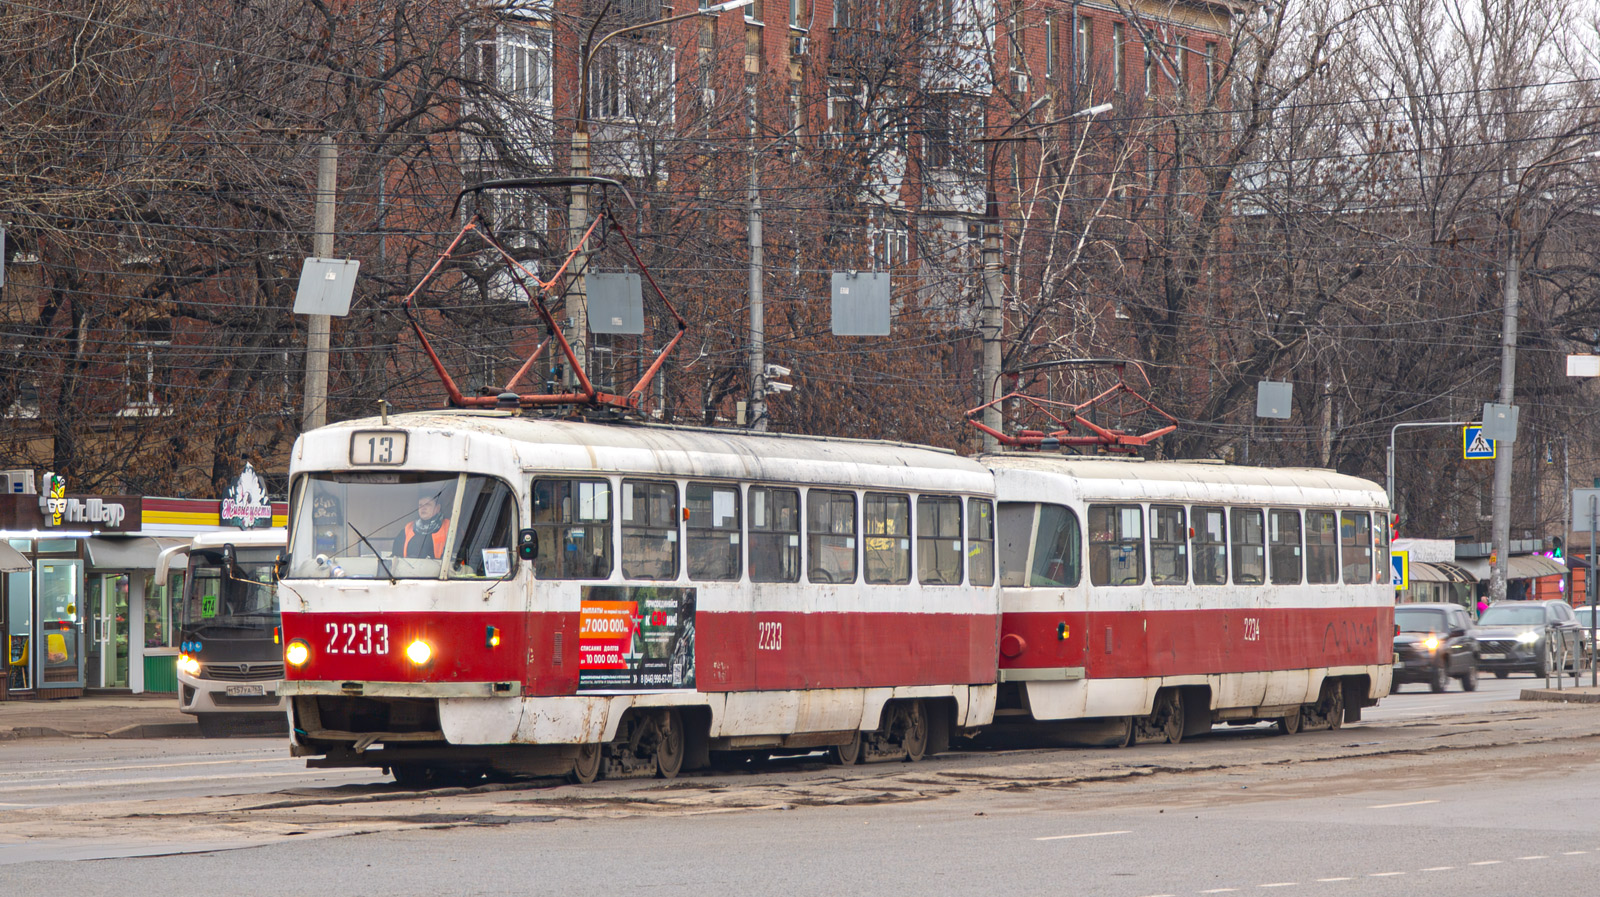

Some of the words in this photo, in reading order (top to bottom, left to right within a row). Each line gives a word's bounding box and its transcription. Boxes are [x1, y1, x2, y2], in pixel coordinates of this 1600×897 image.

[368, 437, 393, 463] 13
[87, 498, 125, 527] Шаур
[203, 599, 215, 613] 474
[325, 622, 389, 655] 2233
[758, 621, 782, 650] 2233
[1244, 617, 1260, 641] 2234
[586, 654, 593, 664] 10
[593, 654, 606, 664] 000
[606, 654, 619, 664] 000
